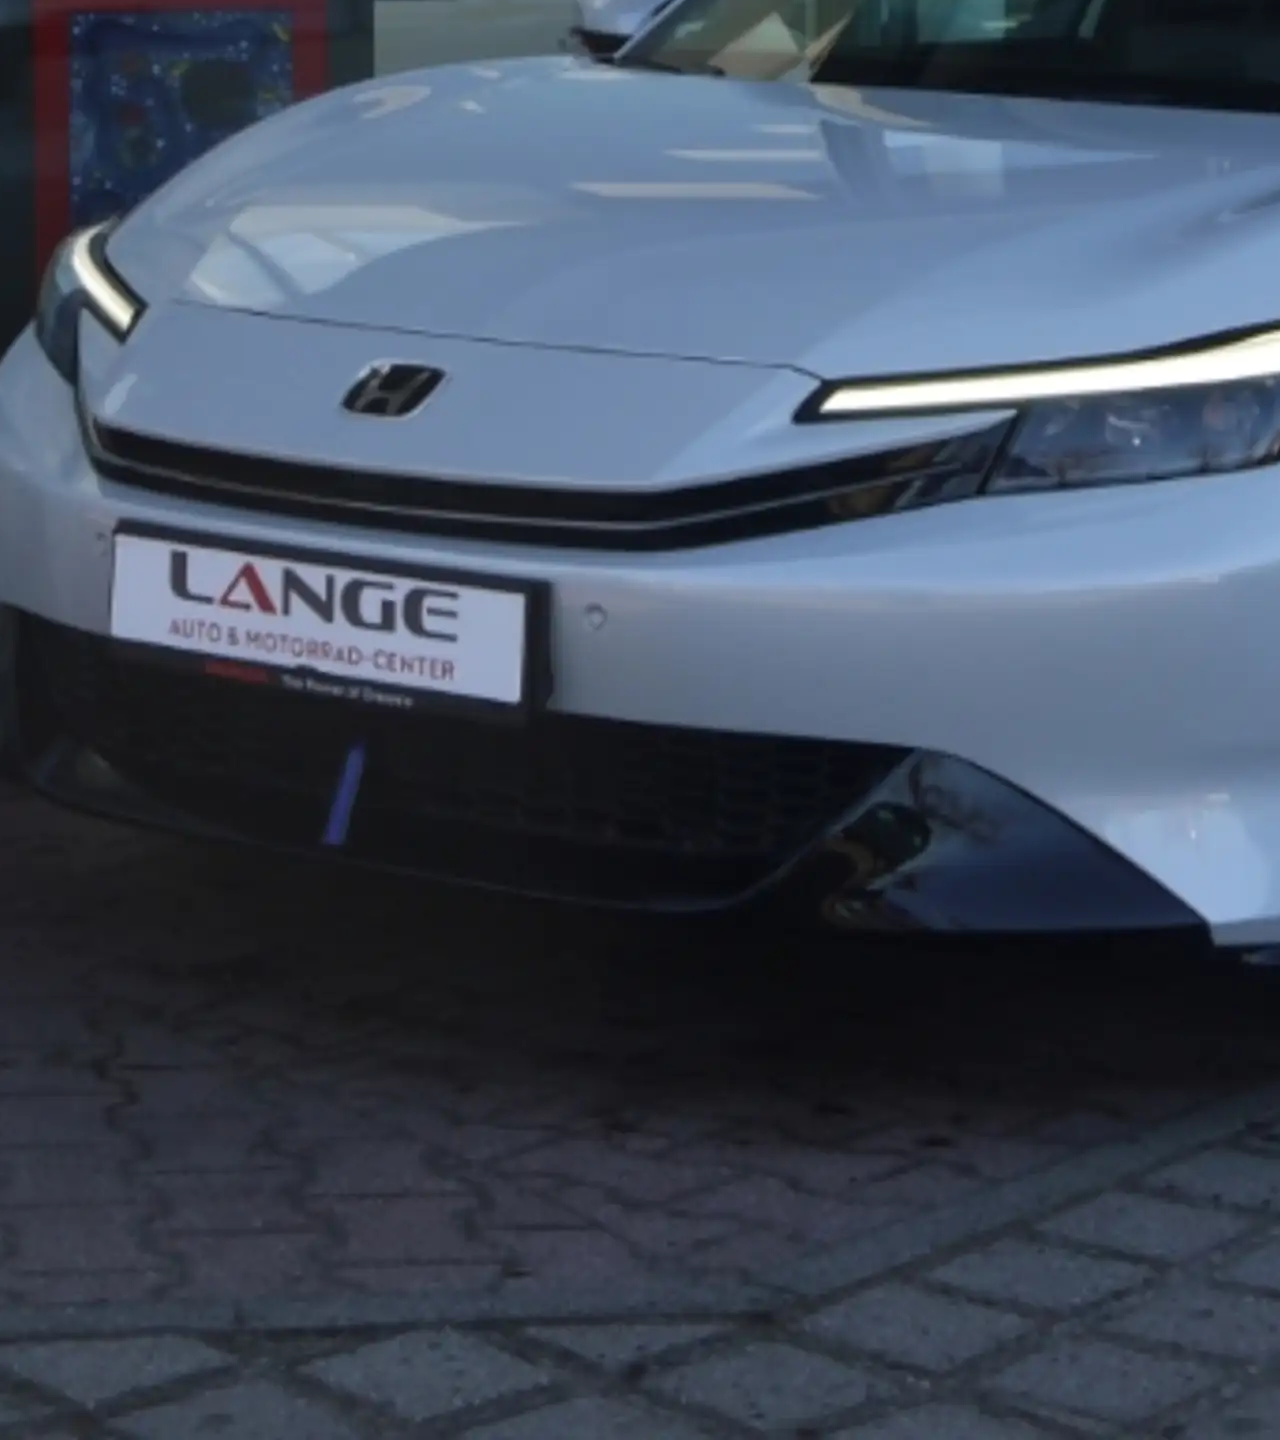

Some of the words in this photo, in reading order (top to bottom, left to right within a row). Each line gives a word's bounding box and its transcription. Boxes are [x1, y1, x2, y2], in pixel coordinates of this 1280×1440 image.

[169, 548, 460, 643] LANGE
[169, 618, 221, 643] AUTO
[227, 626, 240, 647] &
[245, 628, 455, 681] MOTORRAD-CENTER
